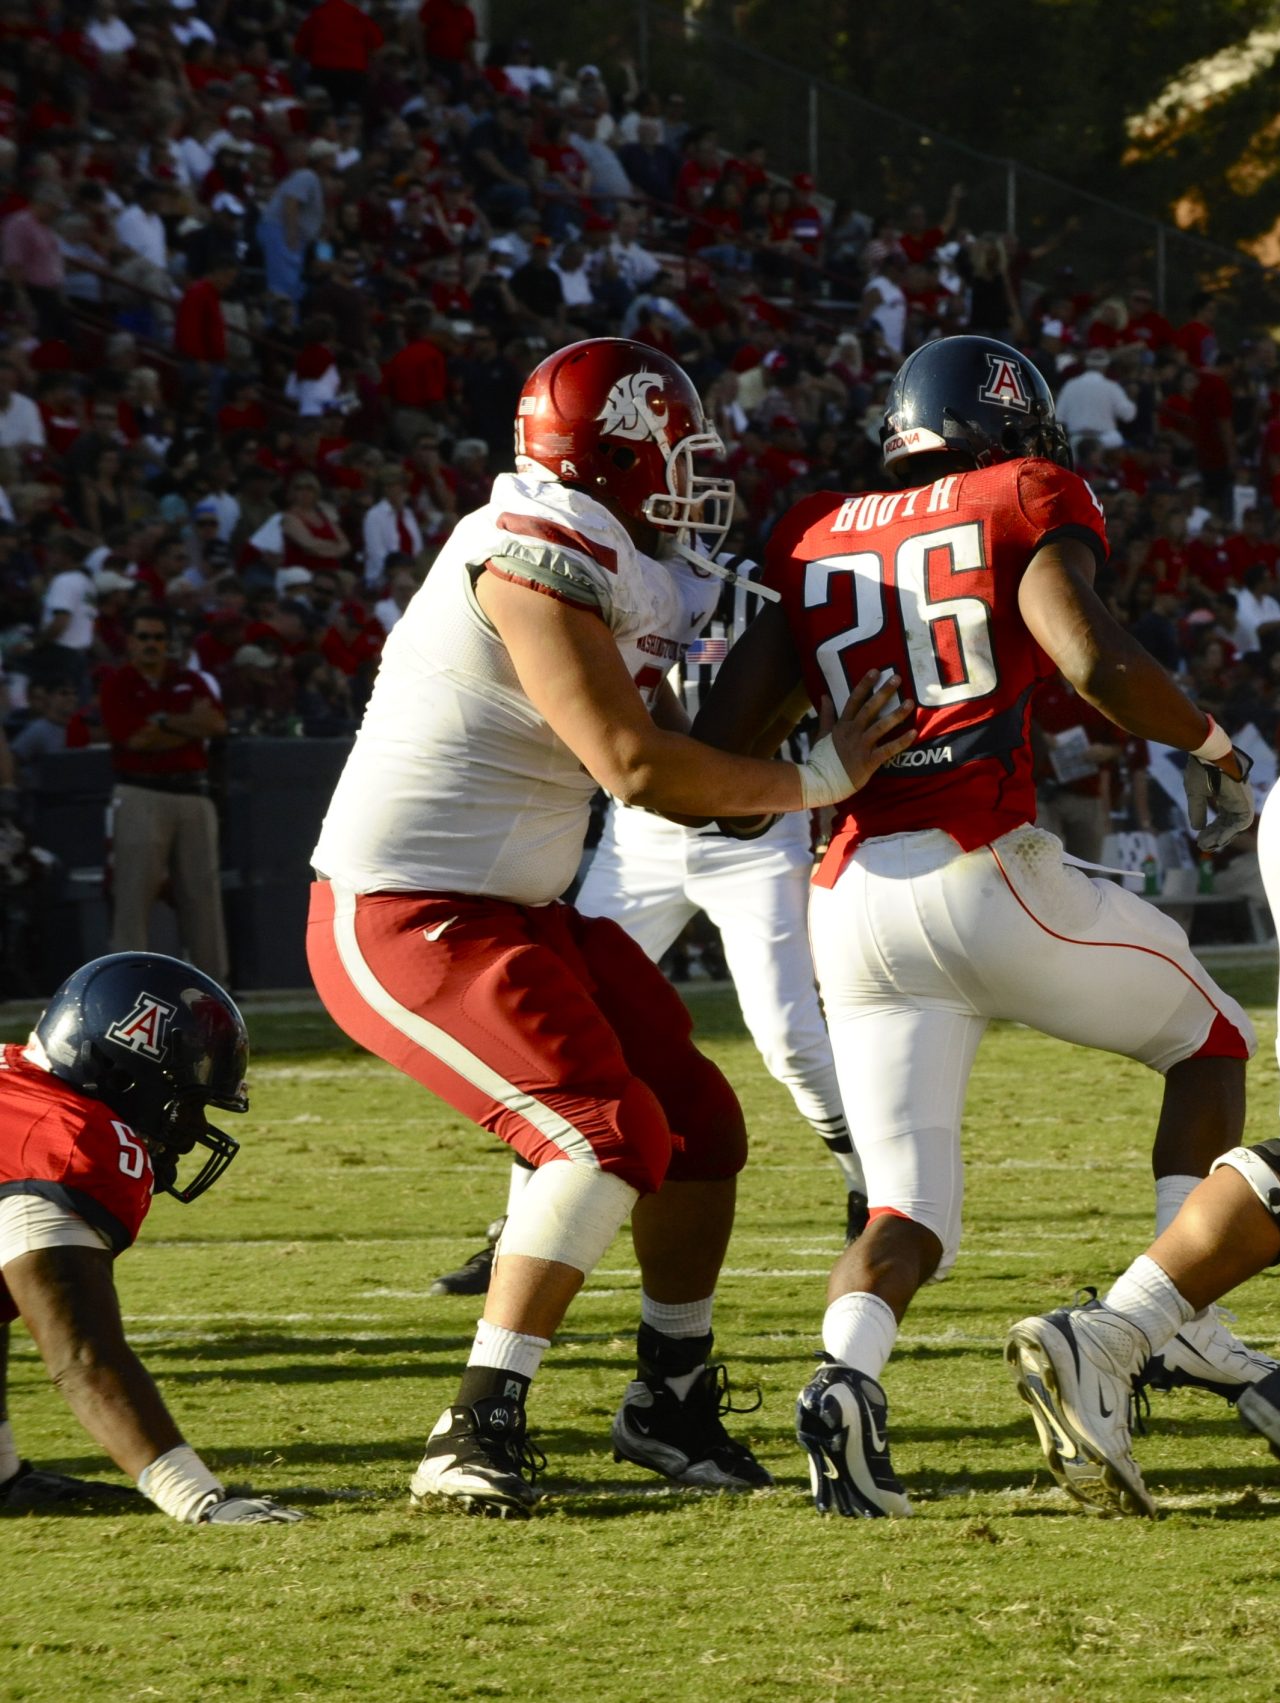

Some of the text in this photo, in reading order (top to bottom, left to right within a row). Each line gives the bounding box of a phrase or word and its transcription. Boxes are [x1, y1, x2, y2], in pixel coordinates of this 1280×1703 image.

[978, 353, 1031, 414] A
[830, 476, 958, 532] BOOTH
[804, 519, 1000, 719] 26
[884, 746, 953, 769] RIZONA
[105, 991, 177, 1063] A
